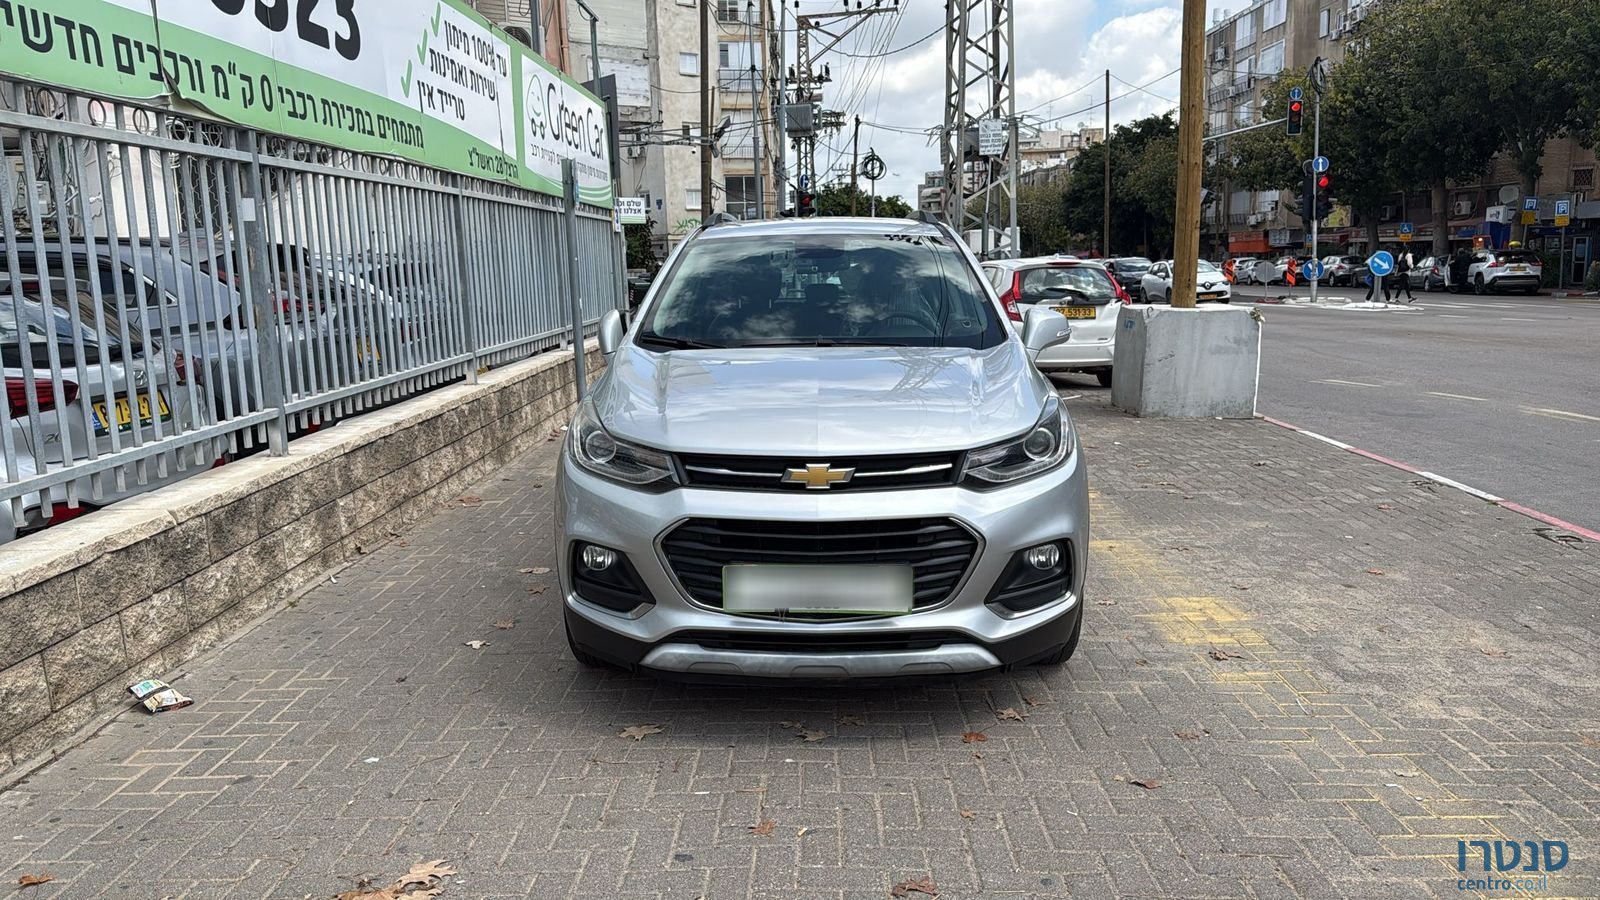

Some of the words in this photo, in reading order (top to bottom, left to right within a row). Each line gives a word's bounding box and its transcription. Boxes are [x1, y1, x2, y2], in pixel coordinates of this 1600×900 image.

[444, 20, 470, 56] מימון
[471, 34, 496, 71] 100%
[429, 47, 468, 88] ואמינות
[496, 53, 507, 77] עד
[211, 61, 254, 109] ק"מ
[260, 74, 273, 112] 0
[417, 80, 436, 114] אין
[469, 69, 496, 101] שירות
[277, 86, 318, 123] רכבי
[320, 98, 375, 136] במכירת
[437, 88, 465, 121] טרייד
[547, 83, 587, 153] Green
[587, 107, 604, 160] Car
[377, 114, 425, 148] מתמחים
[495, 155, 504, 175] 28
[504, 161, 519, 180] הרצל
